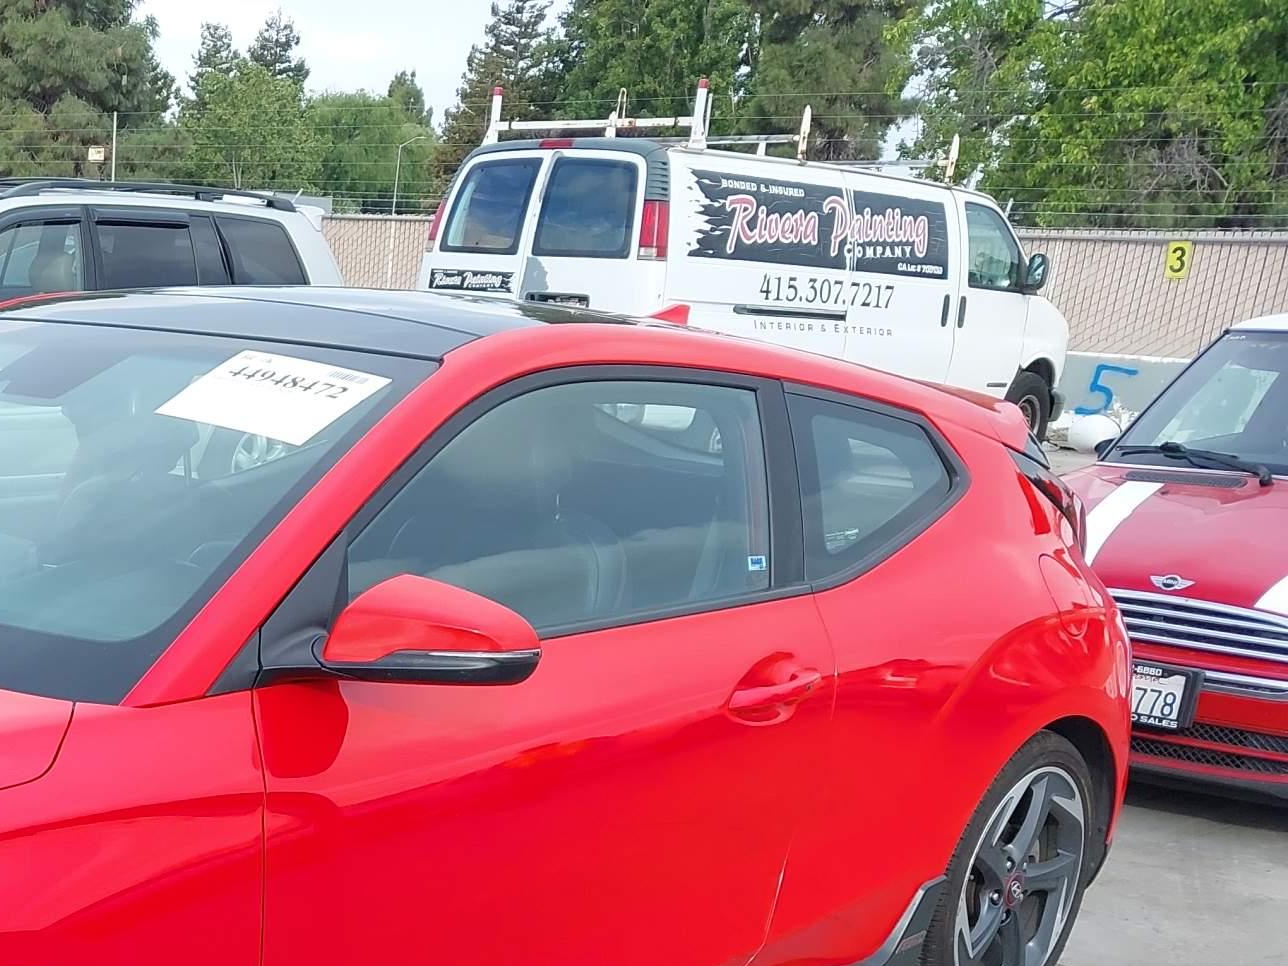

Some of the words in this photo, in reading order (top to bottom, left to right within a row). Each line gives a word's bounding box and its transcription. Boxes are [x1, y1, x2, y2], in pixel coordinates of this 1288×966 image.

[720, 178, 758, 192] BONDED
[769, 184, 805, 197] INSURED
[726, 194, 819, 254] Rivera
[823, 196, 928, 258] Painting
[844, 243, 912, 258] COMPANY
[1169, 246, 1187, 273] 3
[759, 272, 895, 309] 415.307.7217
[228, 365, 349, 399] 44948472
[1074, 364, 1139, 416] 5
[1139, 716, 1179, 729] SALES
